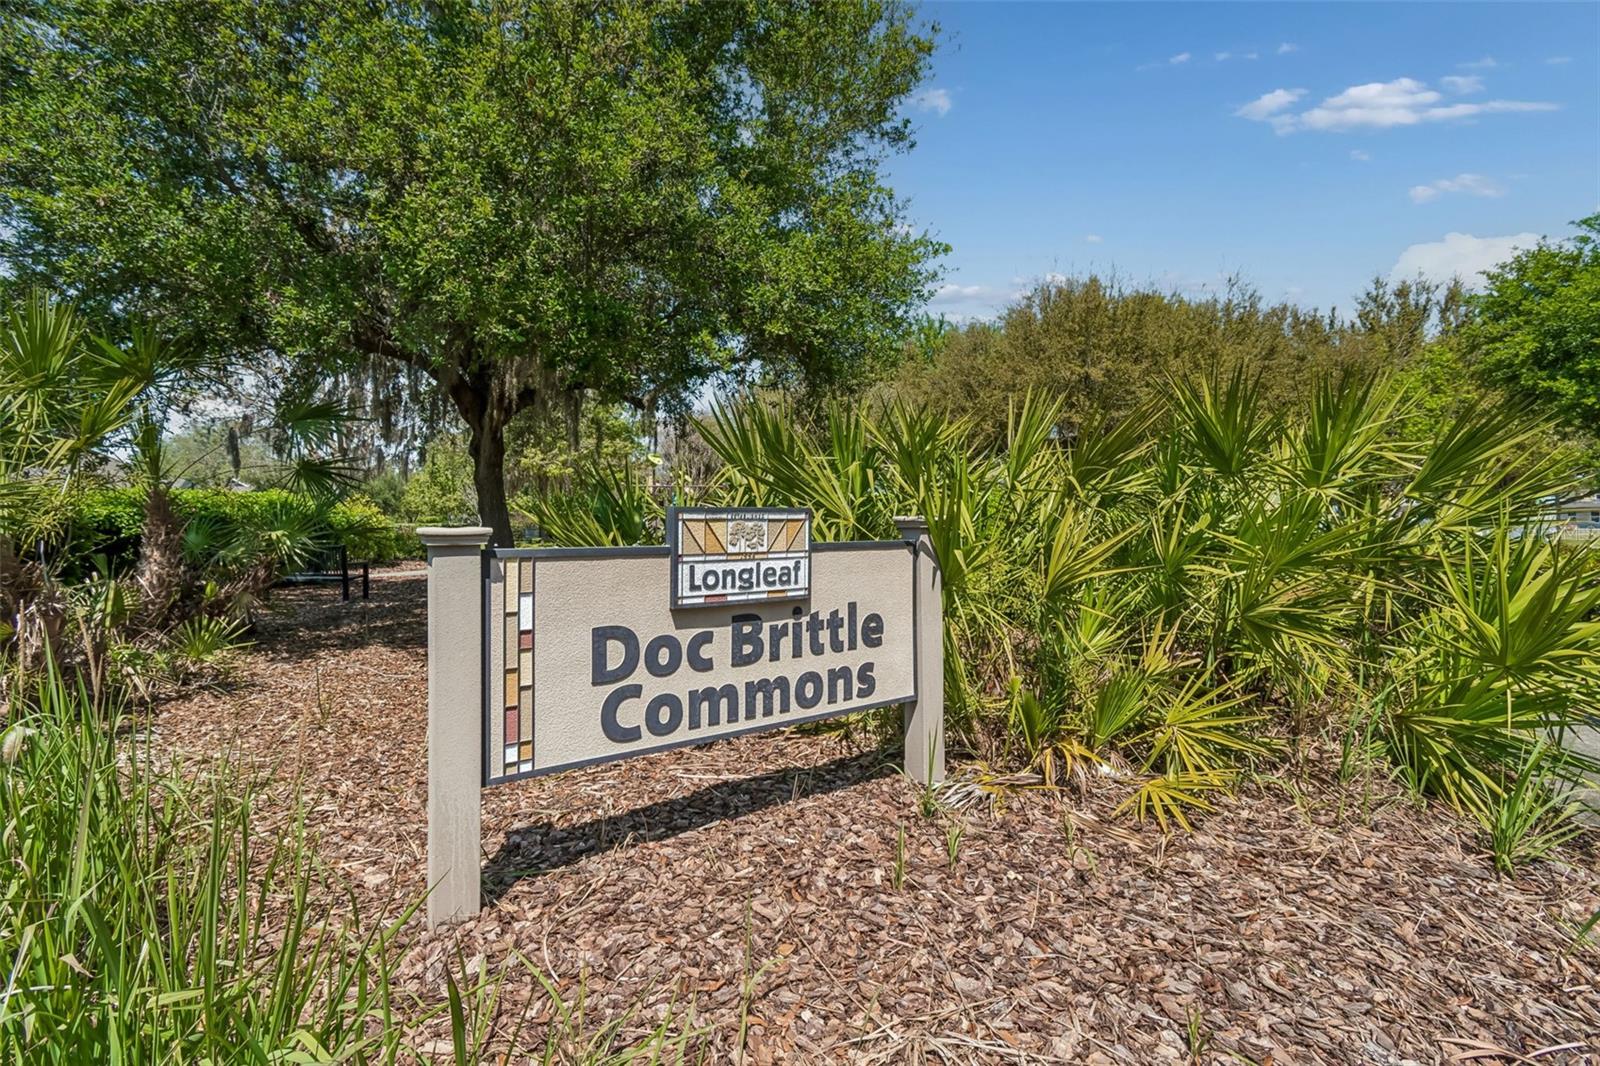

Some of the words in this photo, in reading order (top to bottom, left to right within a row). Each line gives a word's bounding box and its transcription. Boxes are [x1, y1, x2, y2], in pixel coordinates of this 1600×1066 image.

[689, 560, 801, 593] Longleaf
[591, 625, 714, 686] Doc
[731, 602, 884, 667] Brittle
[601, 662, 876, 743] Commons
